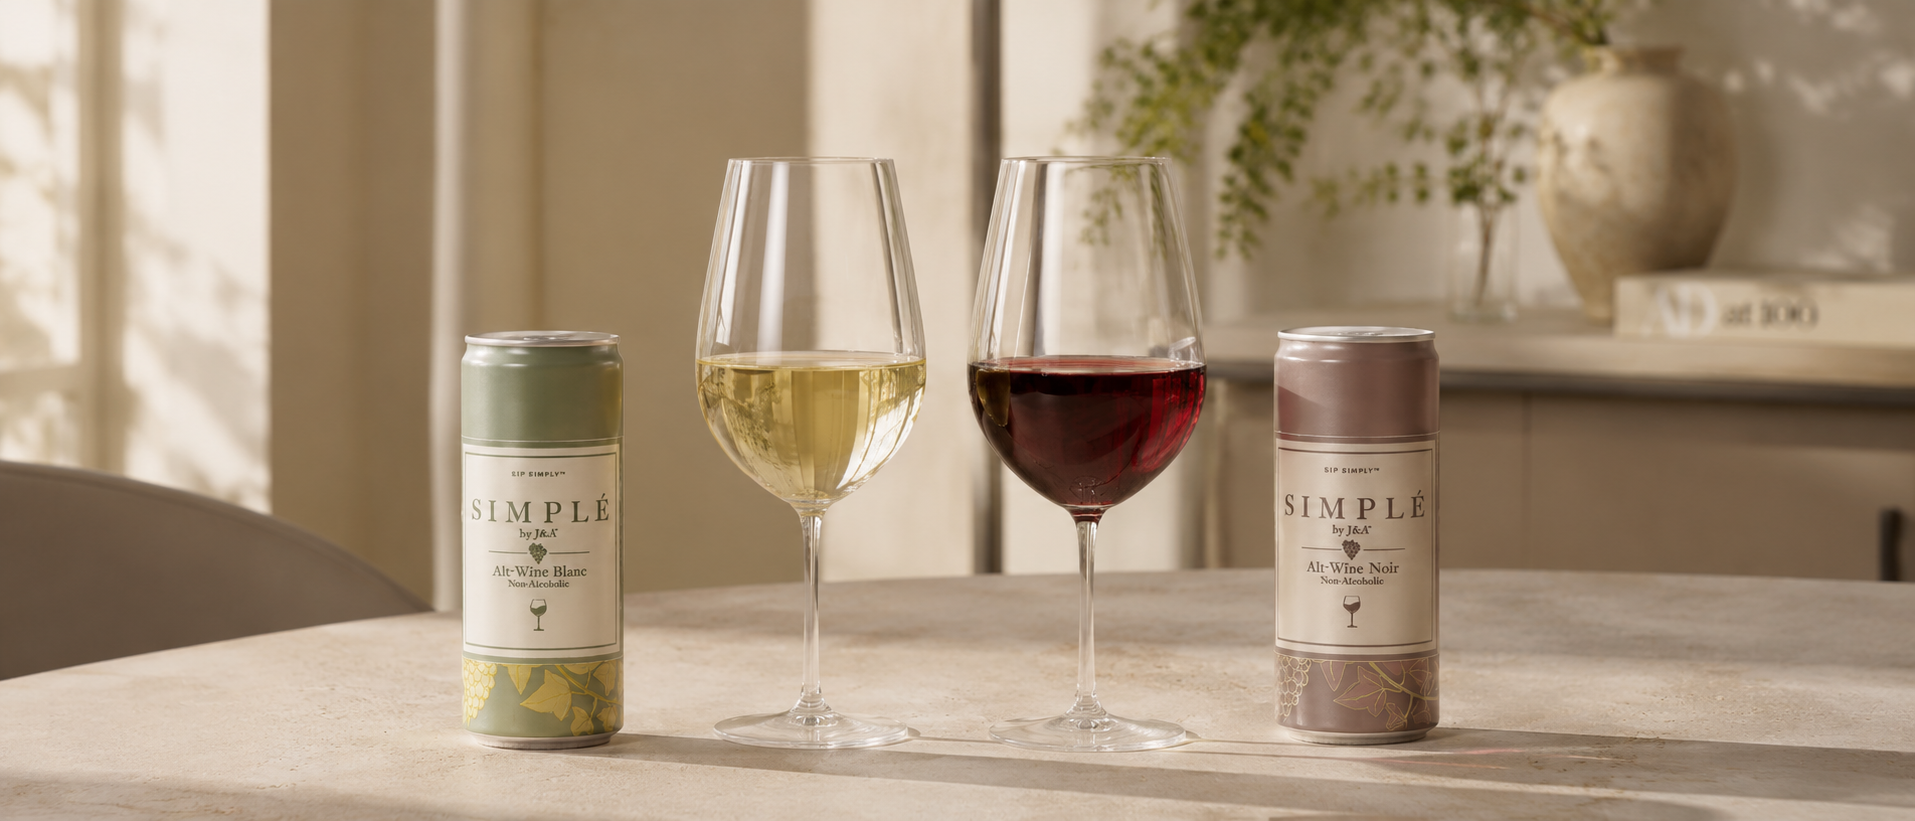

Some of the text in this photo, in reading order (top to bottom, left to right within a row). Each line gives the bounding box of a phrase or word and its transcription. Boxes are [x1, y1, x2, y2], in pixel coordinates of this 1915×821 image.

[511, 470, 526, 478] SIP
[1324, 466, 1339, 474] SIP
[471, 493, 610, 523] SIMPLÉ
[1284, 490, 1426, 520] SIMPLÉ
[519, 528, 532, 541] by
[1332, 524, 1345, 537] by
[492, 565, 588, 578] Alt-Wine Blanc
[1306, 561, 1400, 575] Alt-Wine Noir
